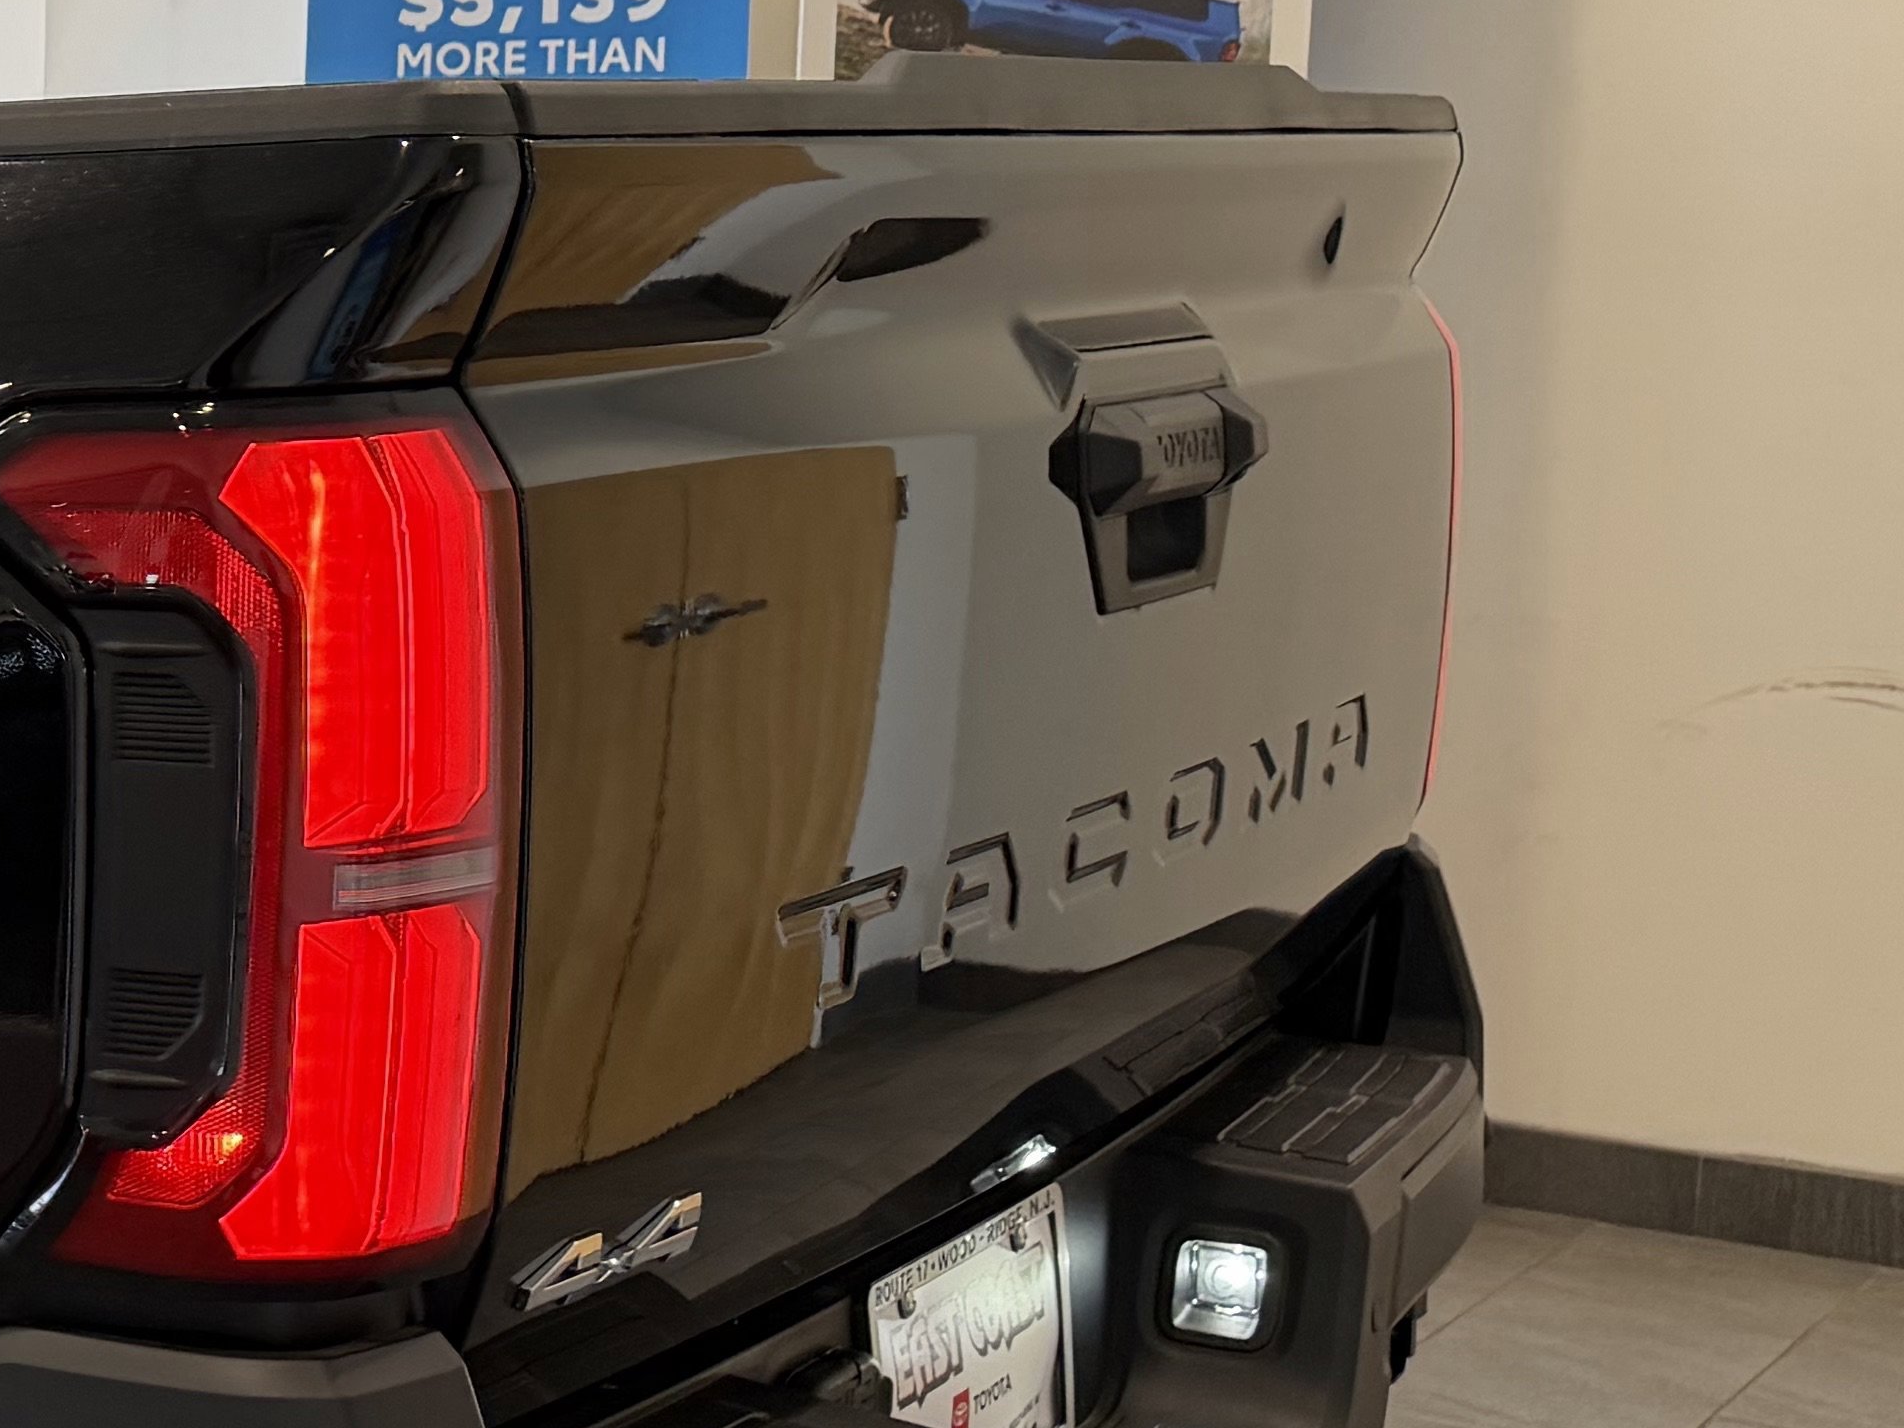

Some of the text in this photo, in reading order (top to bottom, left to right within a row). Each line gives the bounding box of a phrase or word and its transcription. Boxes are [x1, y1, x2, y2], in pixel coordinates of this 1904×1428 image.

[396, 35, 666, 79] MORE THAN
[776, 692, 1369, 1008] TACOMA
[874, 1266, 914, 1309] ROUTE
[937, 1233, 977, 1272] WOOD
[890, 1294, 964, 1410] EAST
[973, 1373, 1012, 1414] TOYOTA
